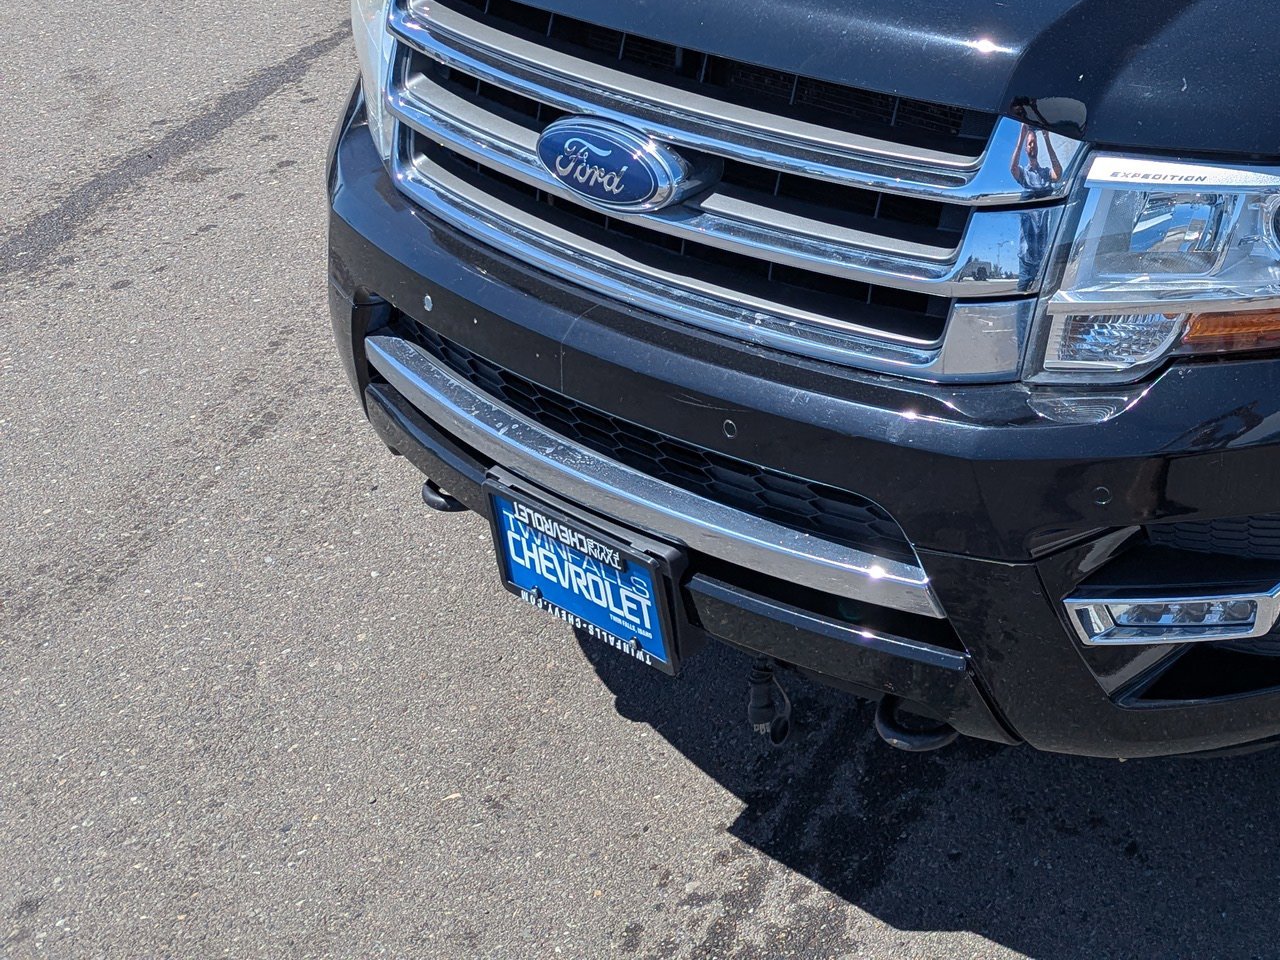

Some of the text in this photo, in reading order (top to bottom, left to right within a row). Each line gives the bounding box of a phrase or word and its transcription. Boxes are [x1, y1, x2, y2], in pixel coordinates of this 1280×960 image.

[555, 137, 629, 195] Ford
[1110, 171, 1208, 182] EXPEDITION
[513, 502, 588, 554] CHEVROLET
[507, 529, 652, 629] CHEVROLET
